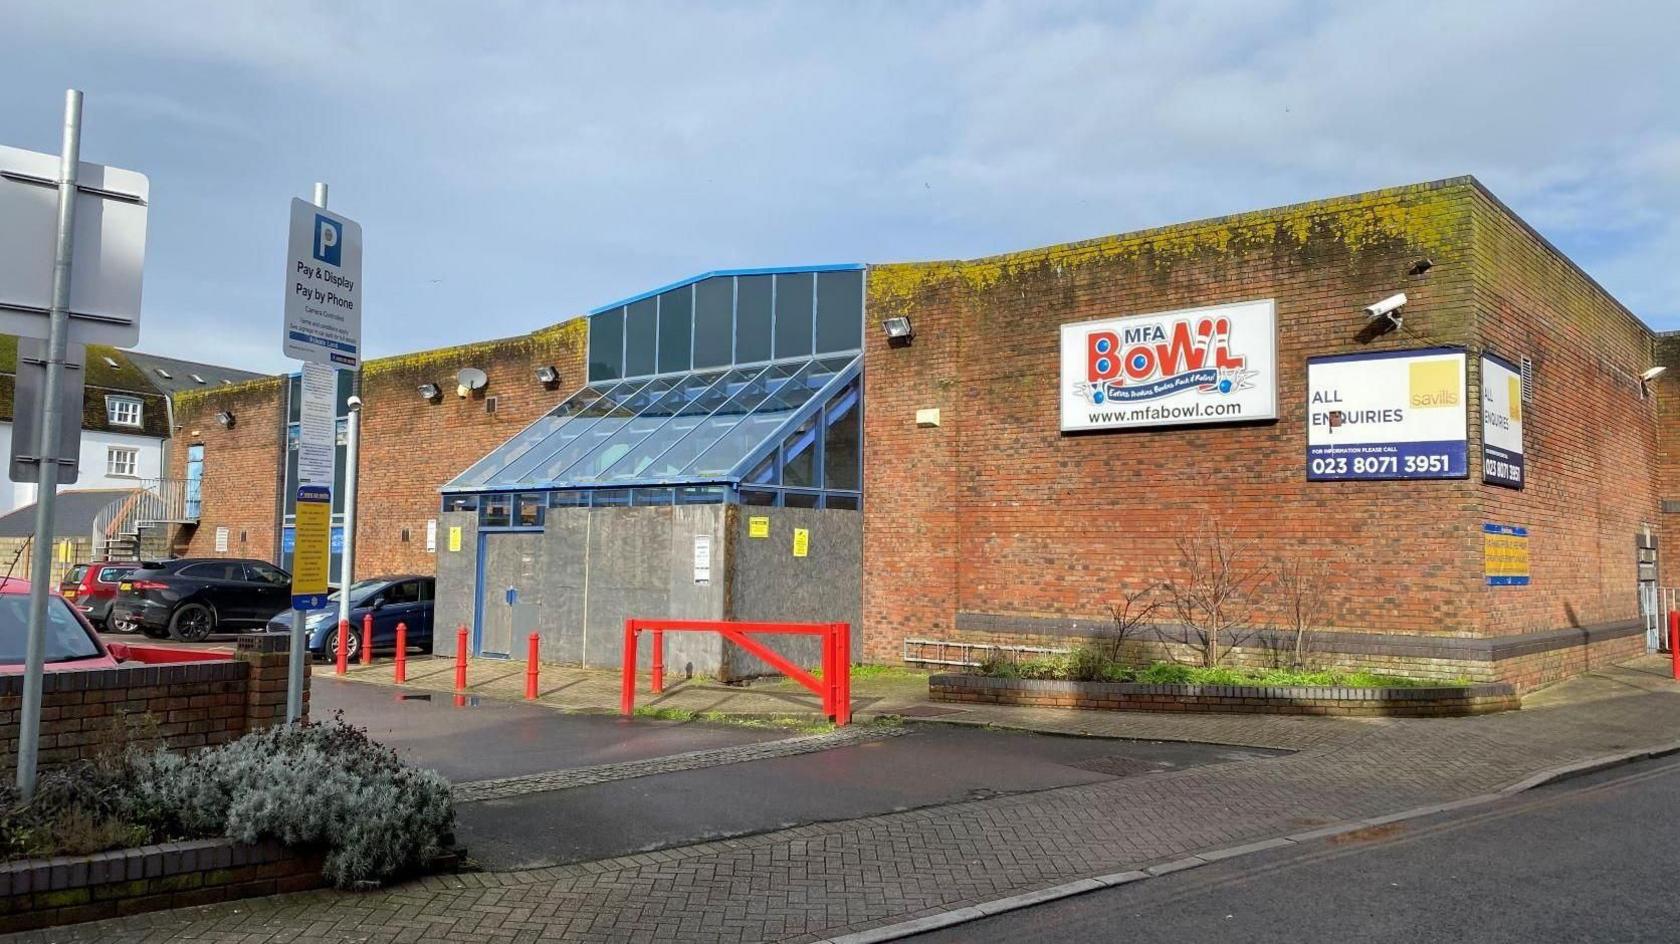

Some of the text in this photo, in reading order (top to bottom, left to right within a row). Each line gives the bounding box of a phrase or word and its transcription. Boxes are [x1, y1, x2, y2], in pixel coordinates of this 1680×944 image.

[320, 221, 338, 257] P
[297, 261, 354, 291] Pay & Display
[296, 283, 353, 310] Pay by Phone
[1124, 326, 1165, 344] MFA
[1312, 390, 1343, 404] ALL
[1412, 390, 1458, 406] savills
[1089, 402, 1242, 423] www.mfabowl.com
[1312, 455, 1449, 474] 023 8071 3951
